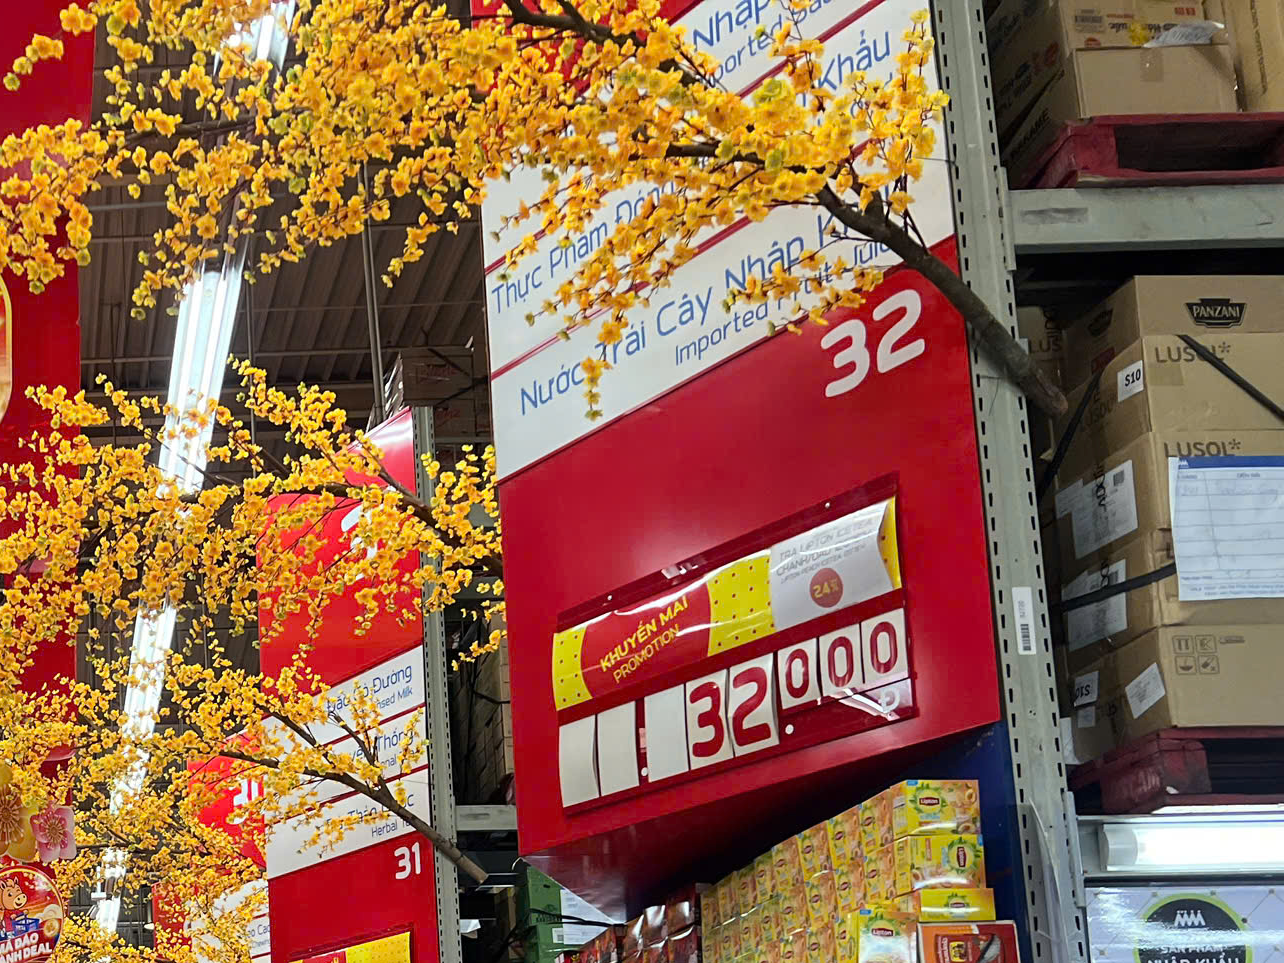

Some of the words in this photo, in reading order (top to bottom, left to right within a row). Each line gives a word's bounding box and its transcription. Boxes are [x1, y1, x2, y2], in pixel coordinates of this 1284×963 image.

[656, 286, 714, 337] Cây
[1192, 306, 1241, 319] PANZANI
[675, 302, 769, 366] Imported
[820, 289, 926, 398] 32
[1124, 368, 1141, 387] S10
[613, 623, 680, 684] PROMOTION
[397, 685, 413, 699] Milk
[371, 820, 398, 839] Herbal
[394, 842, 421, 880] 31
[22, 943, 53, 961] DEAL
